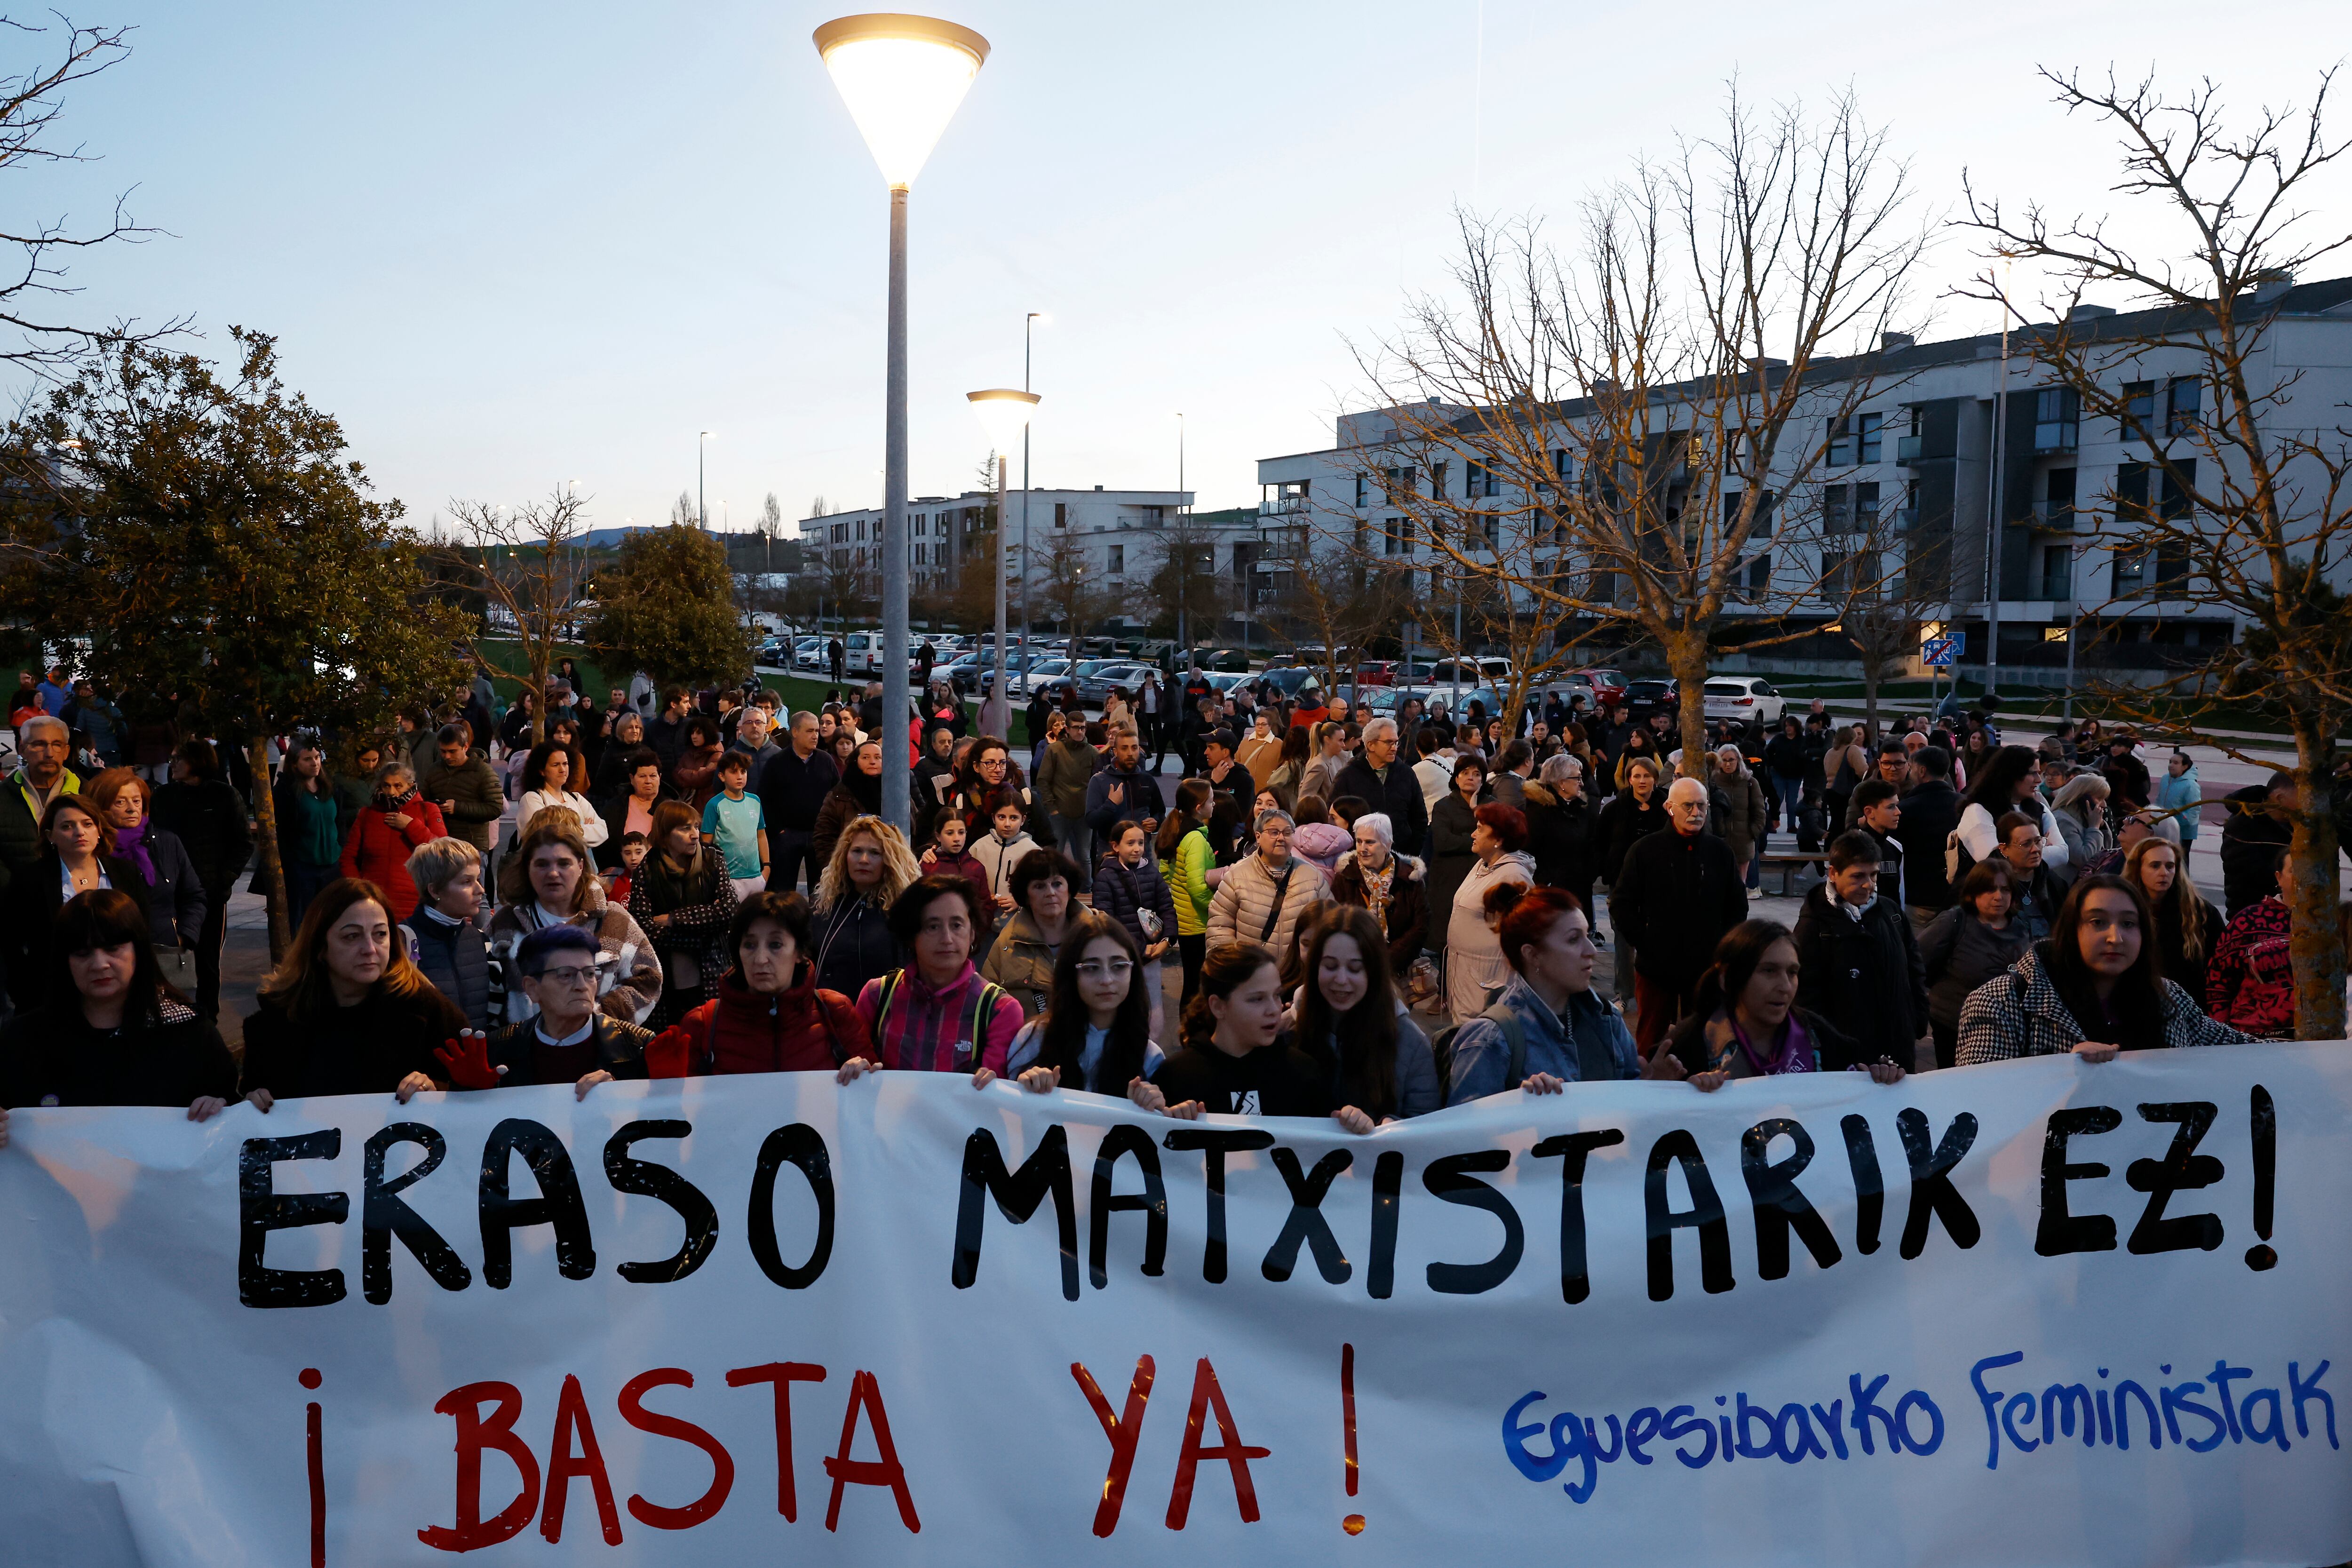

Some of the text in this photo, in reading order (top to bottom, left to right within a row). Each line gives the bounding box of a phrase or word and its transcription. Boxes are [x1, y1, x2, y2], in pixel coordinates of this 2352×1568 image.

[238, 1118, 835, 1309] ERASO
[952, 1107, 1981, 1305] MATXISTARIK
[417, 1362, 921, 1553] BASTA
[1071, 1353, 1271, 1537] YA
